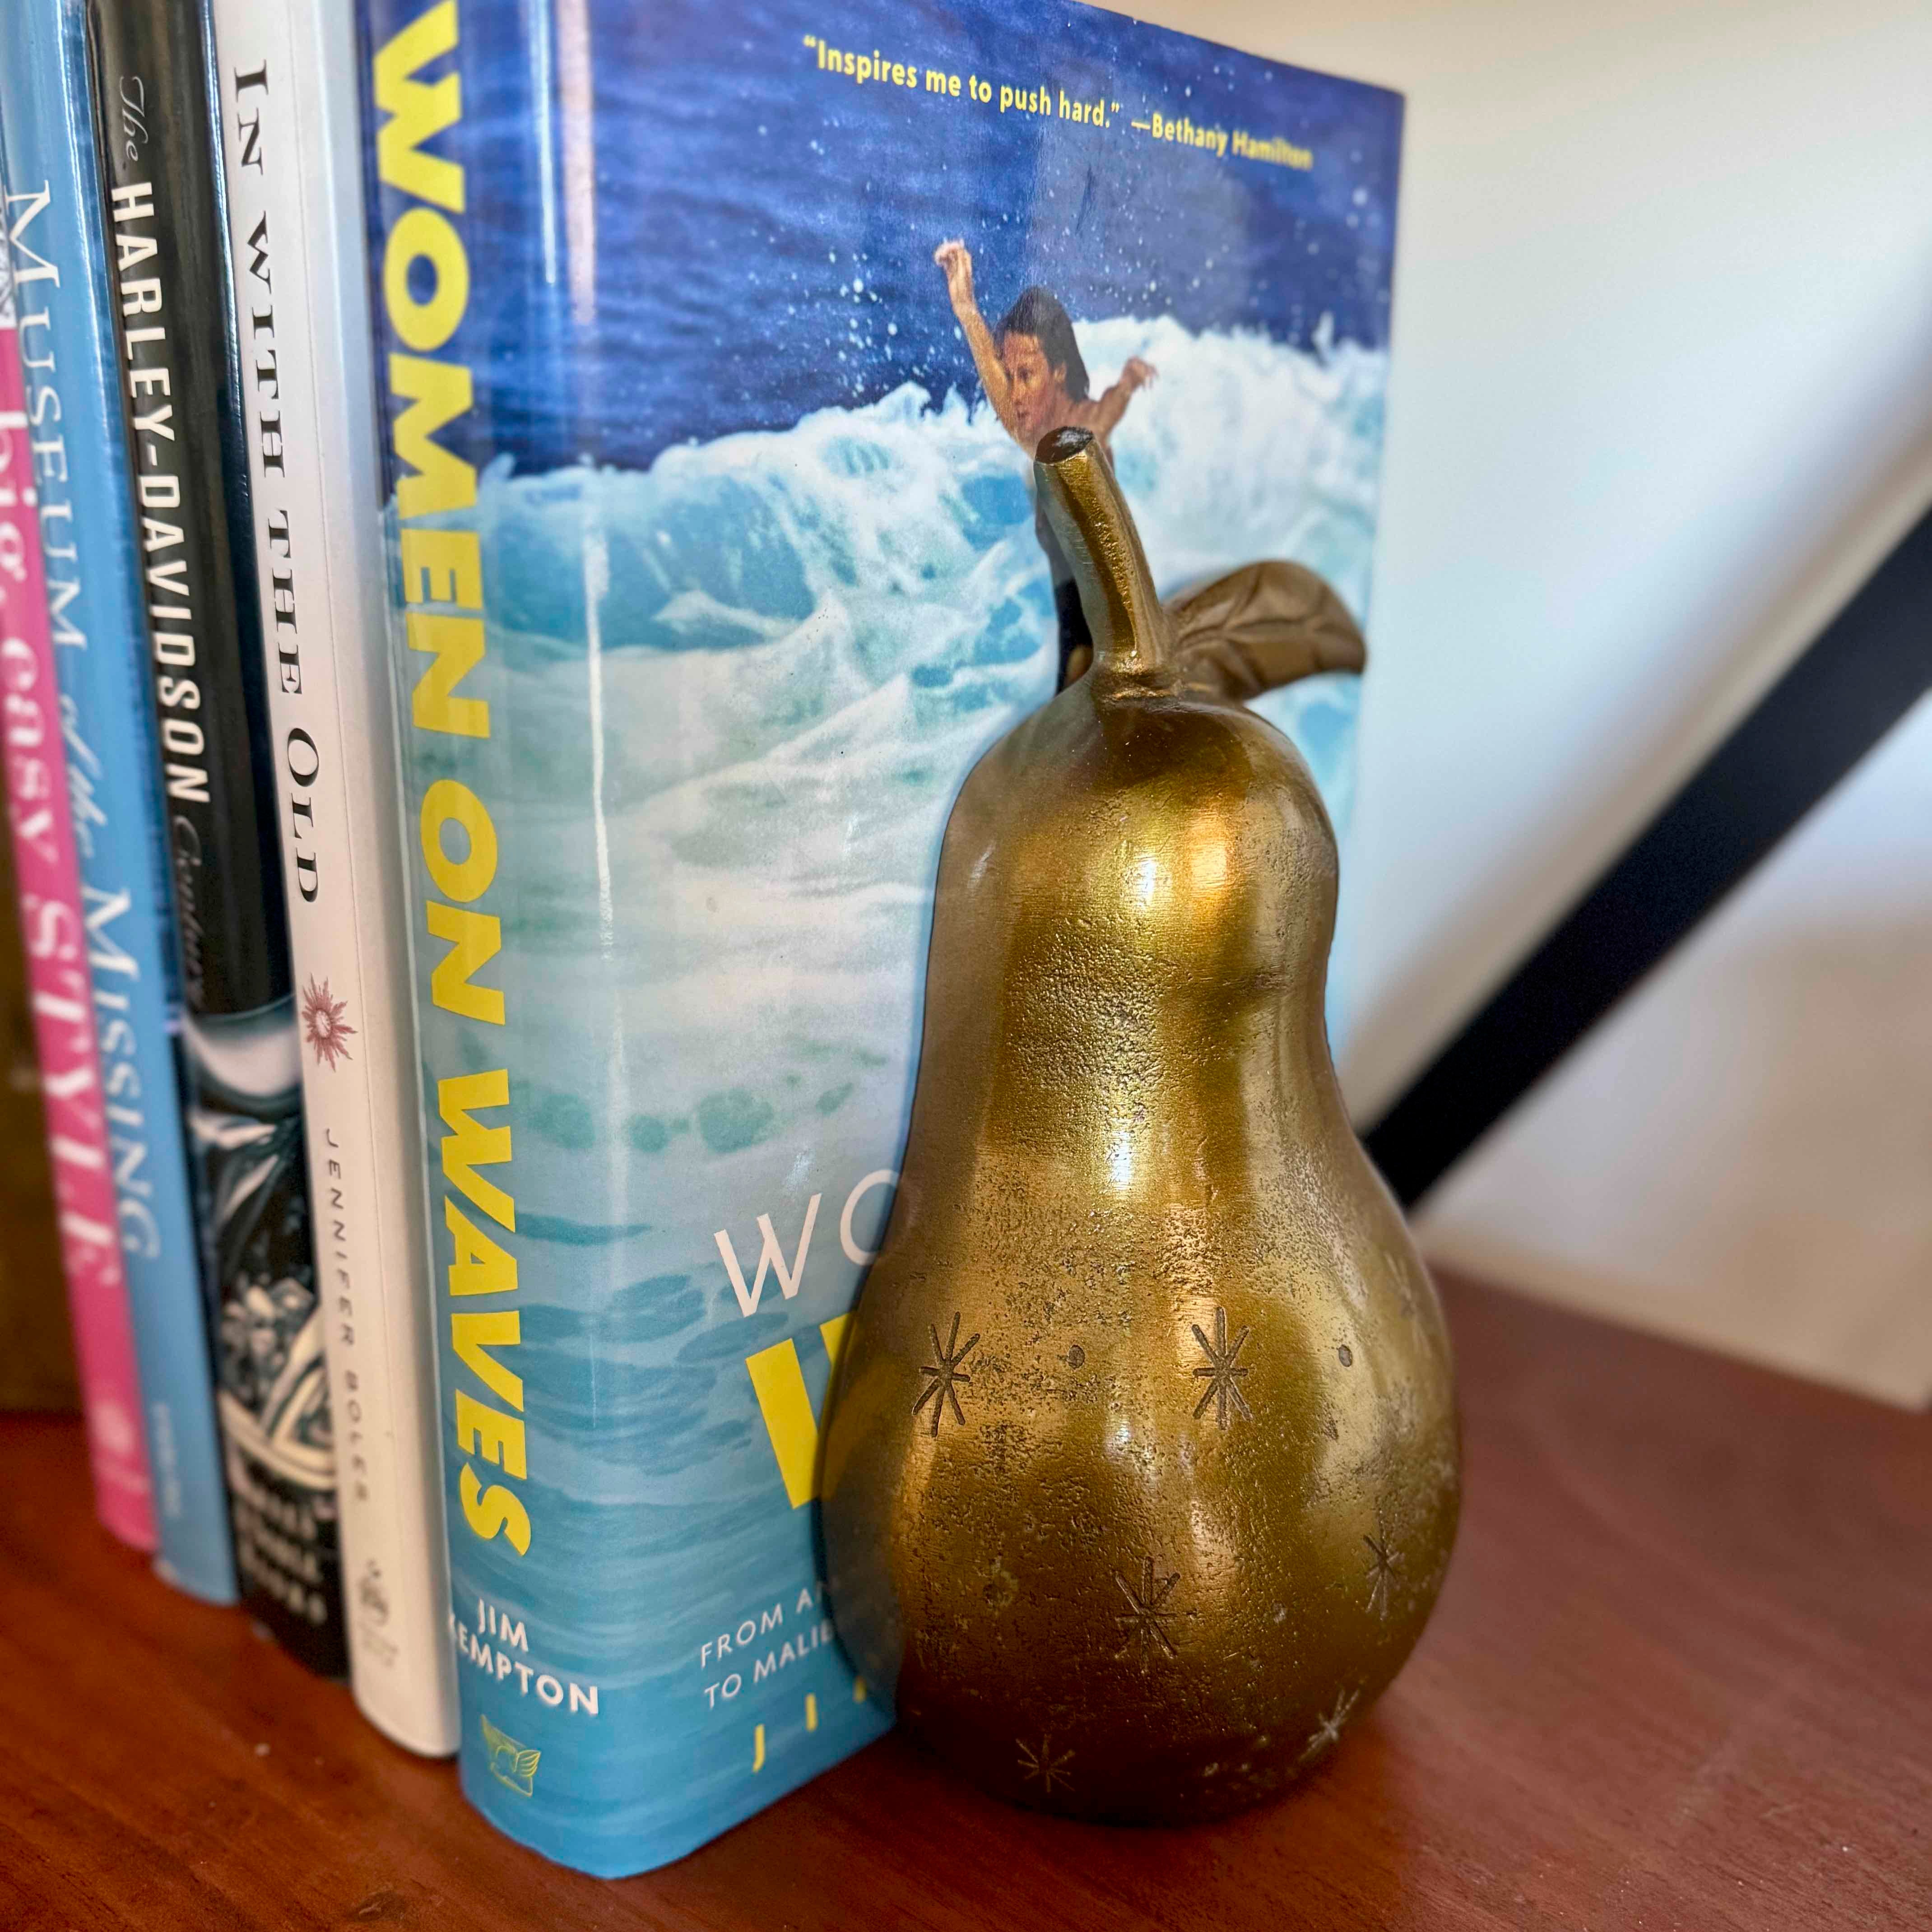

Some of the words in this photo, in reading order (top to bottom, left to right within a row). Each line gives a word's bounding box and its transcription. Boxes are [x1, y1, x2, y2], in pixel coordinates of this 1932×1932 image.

[119, 75, 148, 162] The
[234, 59, 269, 175] IN
[803, 34, 917, 88] “Inspires
[926, 69, 961, 97] me
[969, 74, 992, 103] to
[1000, 84, 1051, 115] push
[1059, 88, 1120, 129] hard.”
[1232, 130, 1313, 172] Hamilton
[5, 179, 88, 651] MUSEUM
[247, 210, 285, 478] WITH
[374, 0, 490, 739] WOMEN
[111, 182, 210, 803] HARLEY-DAVIDSON
[268, 509, 302, 695] THE
[60, 694, 102, 779] of
[287, 727, 319, 903] OLD
[420, 779, 505, 1026] ON
[22, 893, 121, 1292] STYLE
[80, 888, 162, 1259] MISSING
[326, 1128, 355, 1346] JENNIFER
[437, 1068, 531, 1556] WAVES
[478, 1597, 528, 1652] JIM
[700, 1602, 783, 1669] FROM
[704, 1673, 742, 1711] TO
